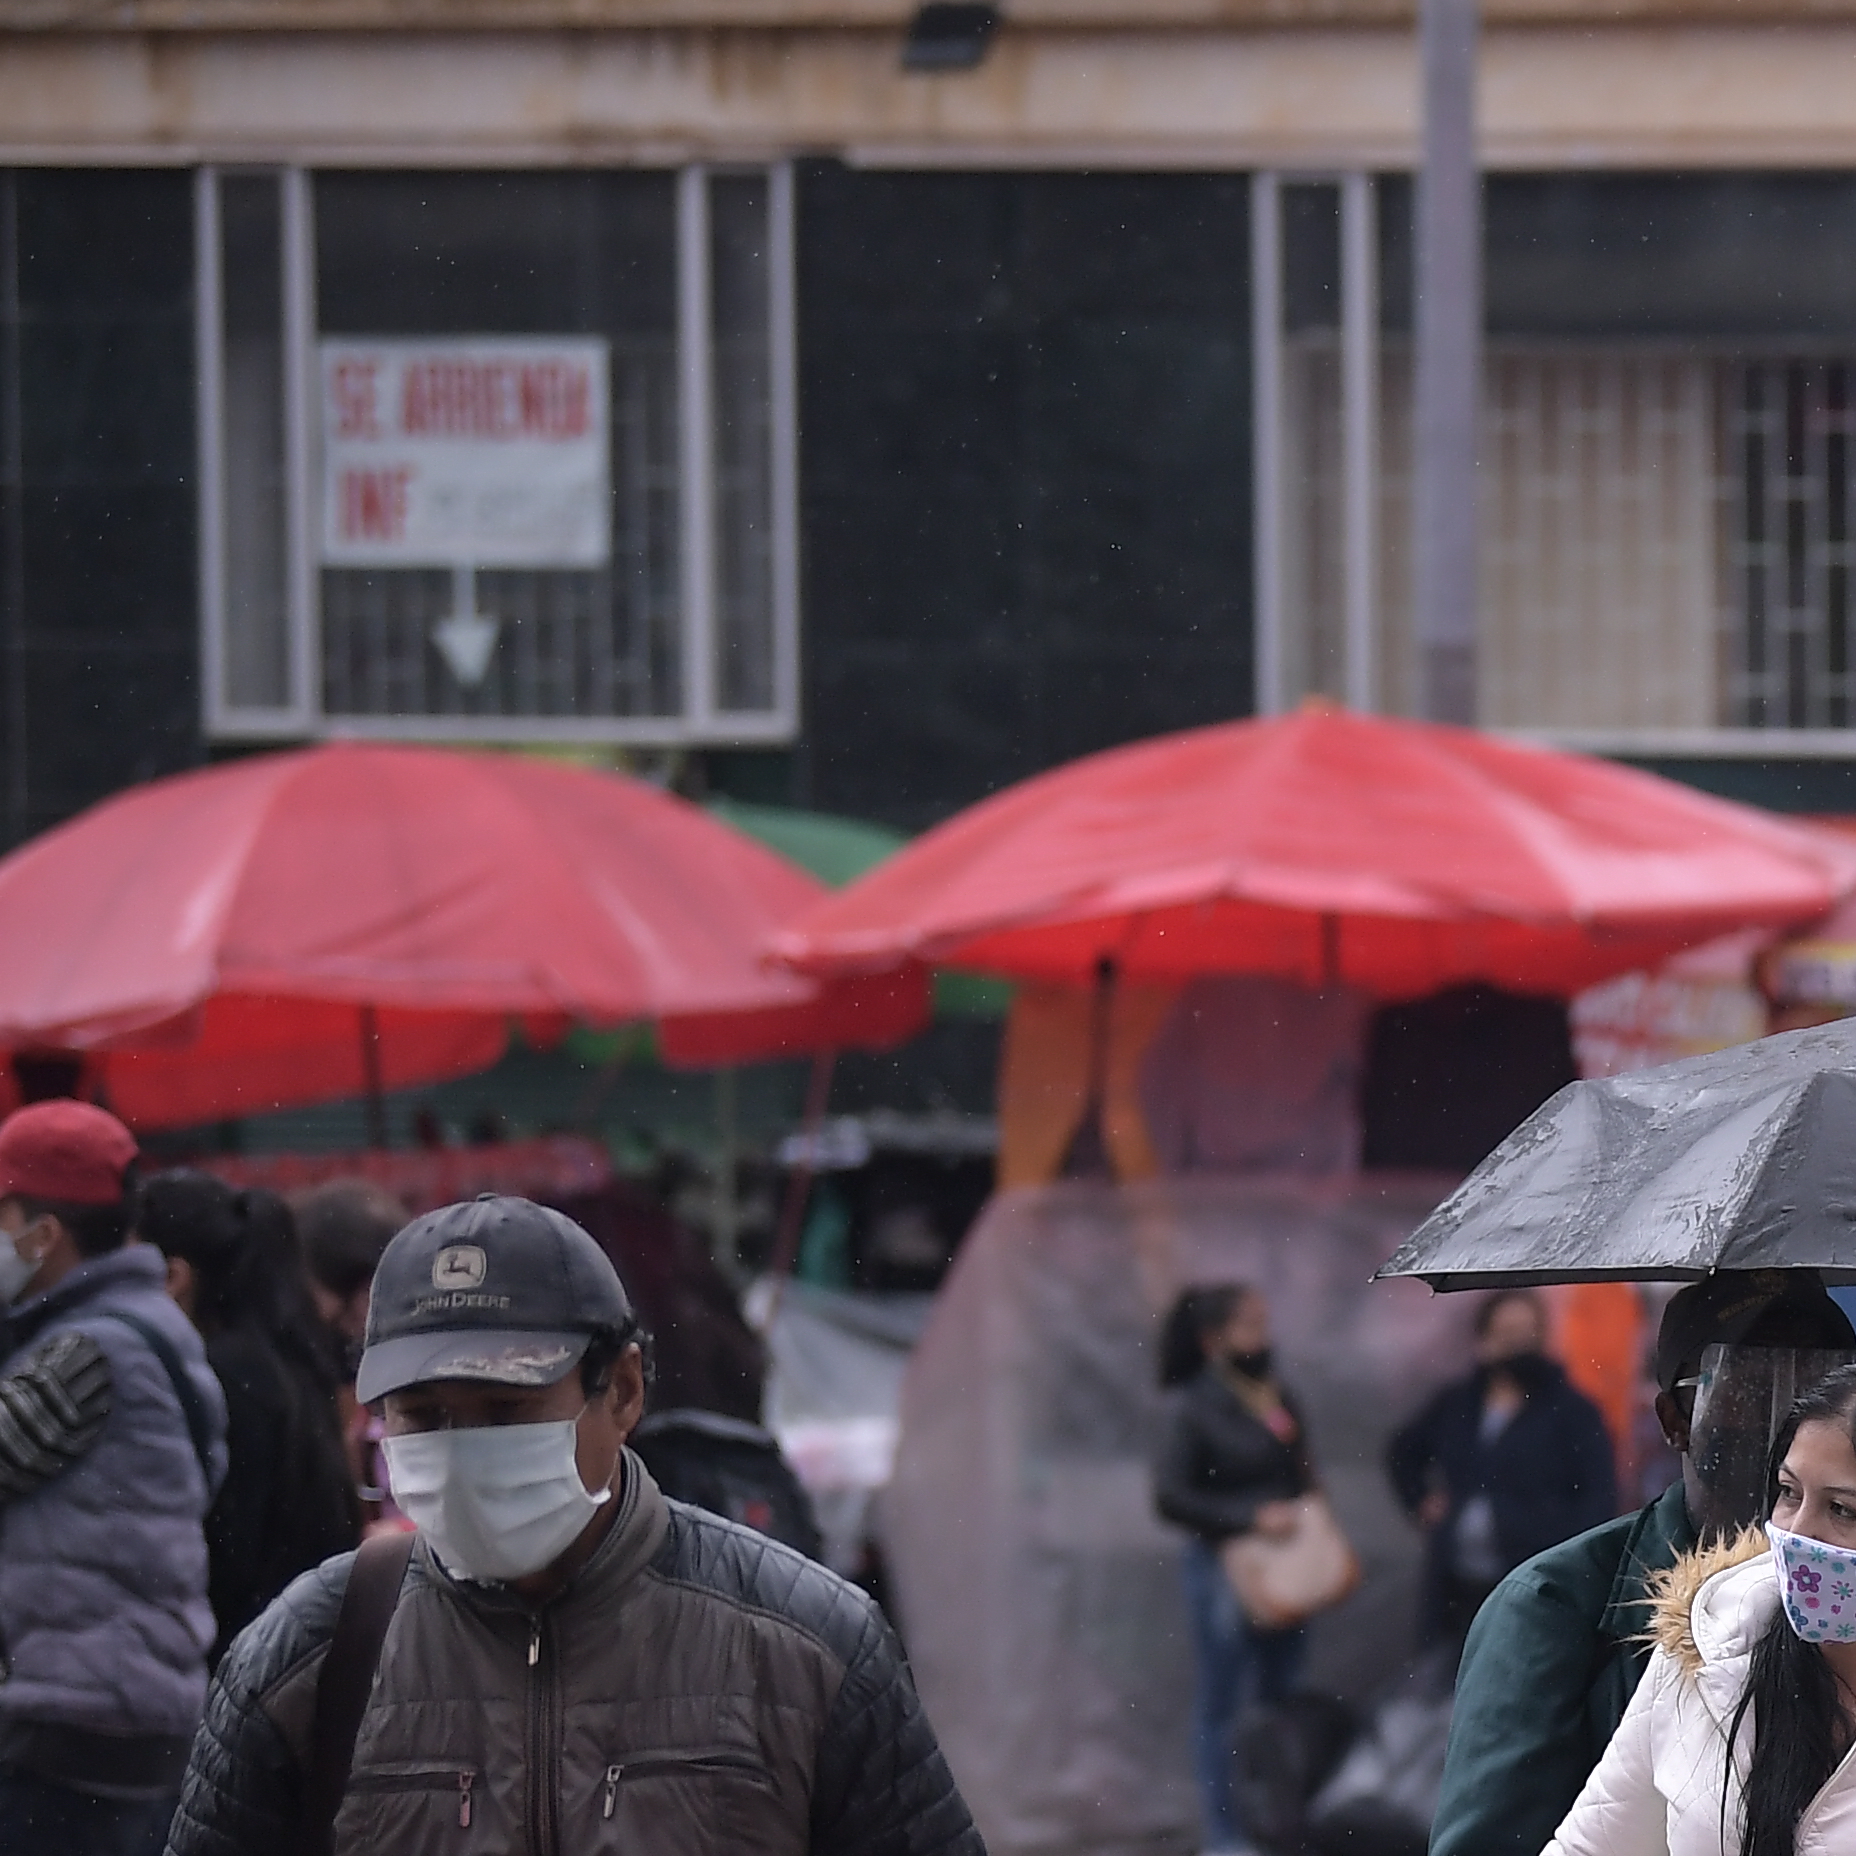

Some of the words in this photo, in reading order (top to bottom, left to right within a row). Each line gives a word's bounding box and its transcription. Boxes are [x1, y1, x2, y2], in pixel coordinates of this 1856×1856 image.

[332, 357, 383, 440] SE
[400, 357, 590, 441] ARRIENDA
[451, 1291, 511, 1310] DEERE
